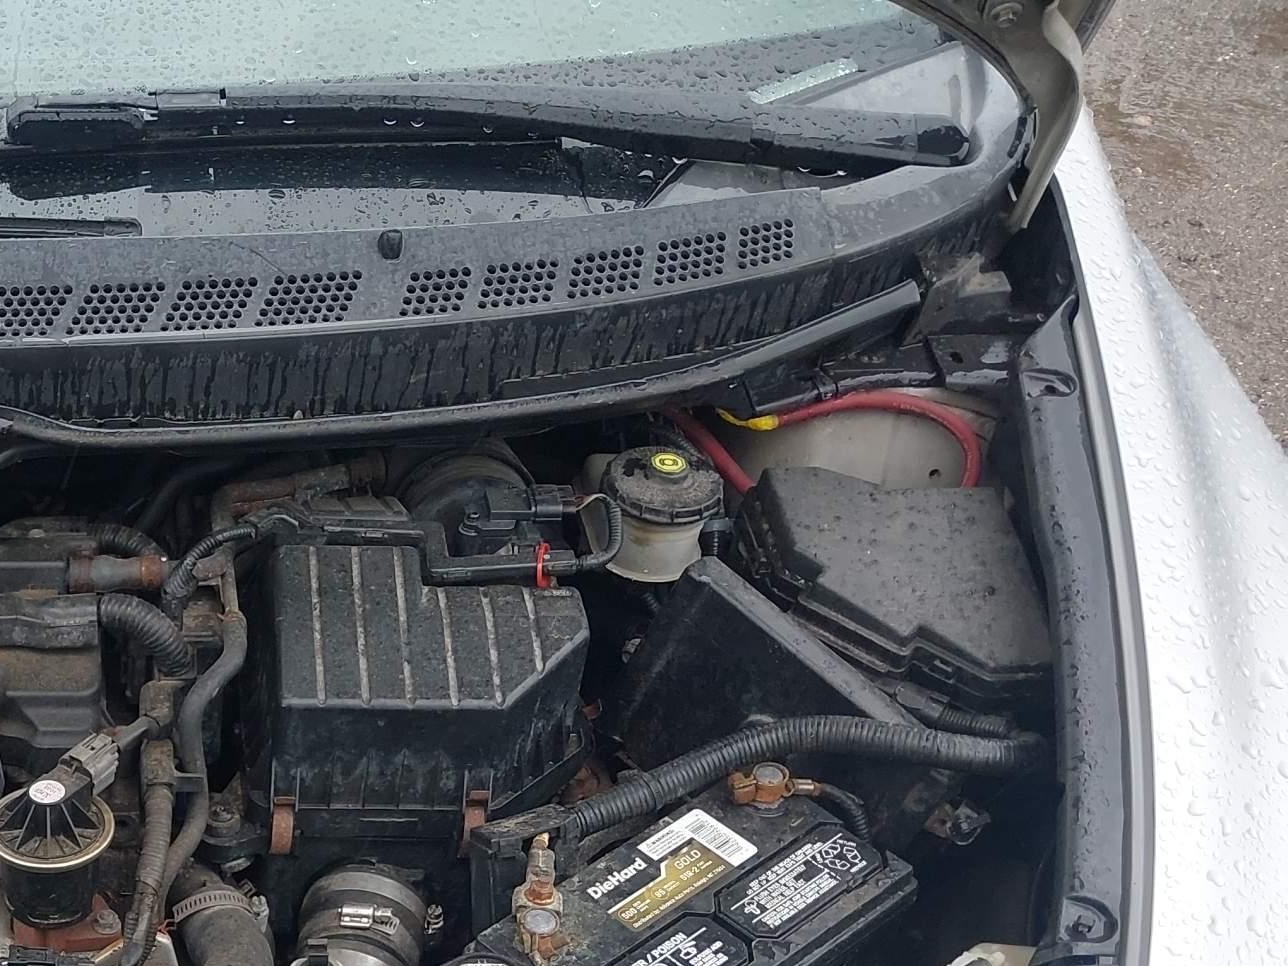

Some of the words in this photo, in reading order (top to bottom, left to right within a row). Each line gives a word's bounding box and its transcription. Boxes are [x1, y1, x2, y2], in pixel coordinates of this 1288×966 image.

[673, 849, 701, 869] GOLD
[586, 856, 648, 900] DieHard
[621, 907, 637, 919] 500
[650, 932, 686, 957] POISON
